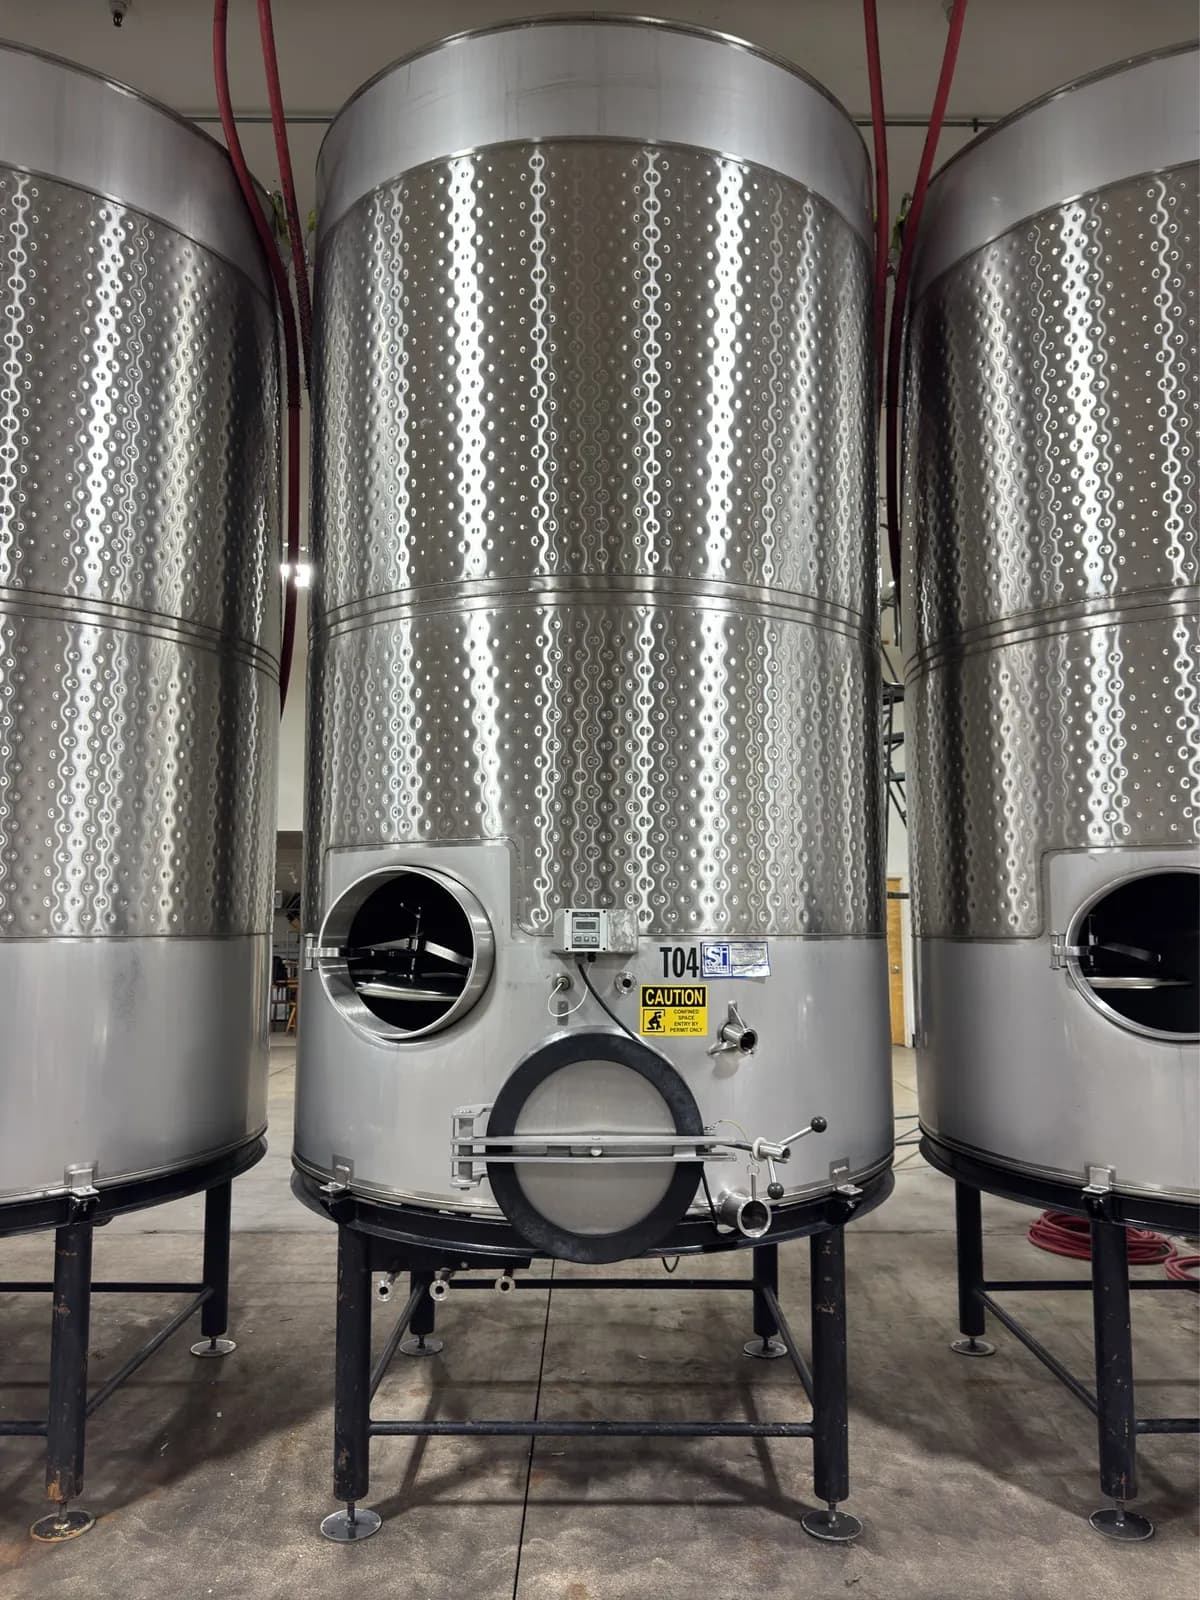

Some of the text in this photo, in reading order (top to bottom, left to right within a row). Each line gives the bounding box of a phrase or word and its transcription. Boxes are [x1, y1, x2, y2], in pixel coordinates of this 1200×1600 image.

[660, 947, 699, 978] T04
[706, 947, 728, 967] Si
[645, 988, 703, 1005] CAUTION
